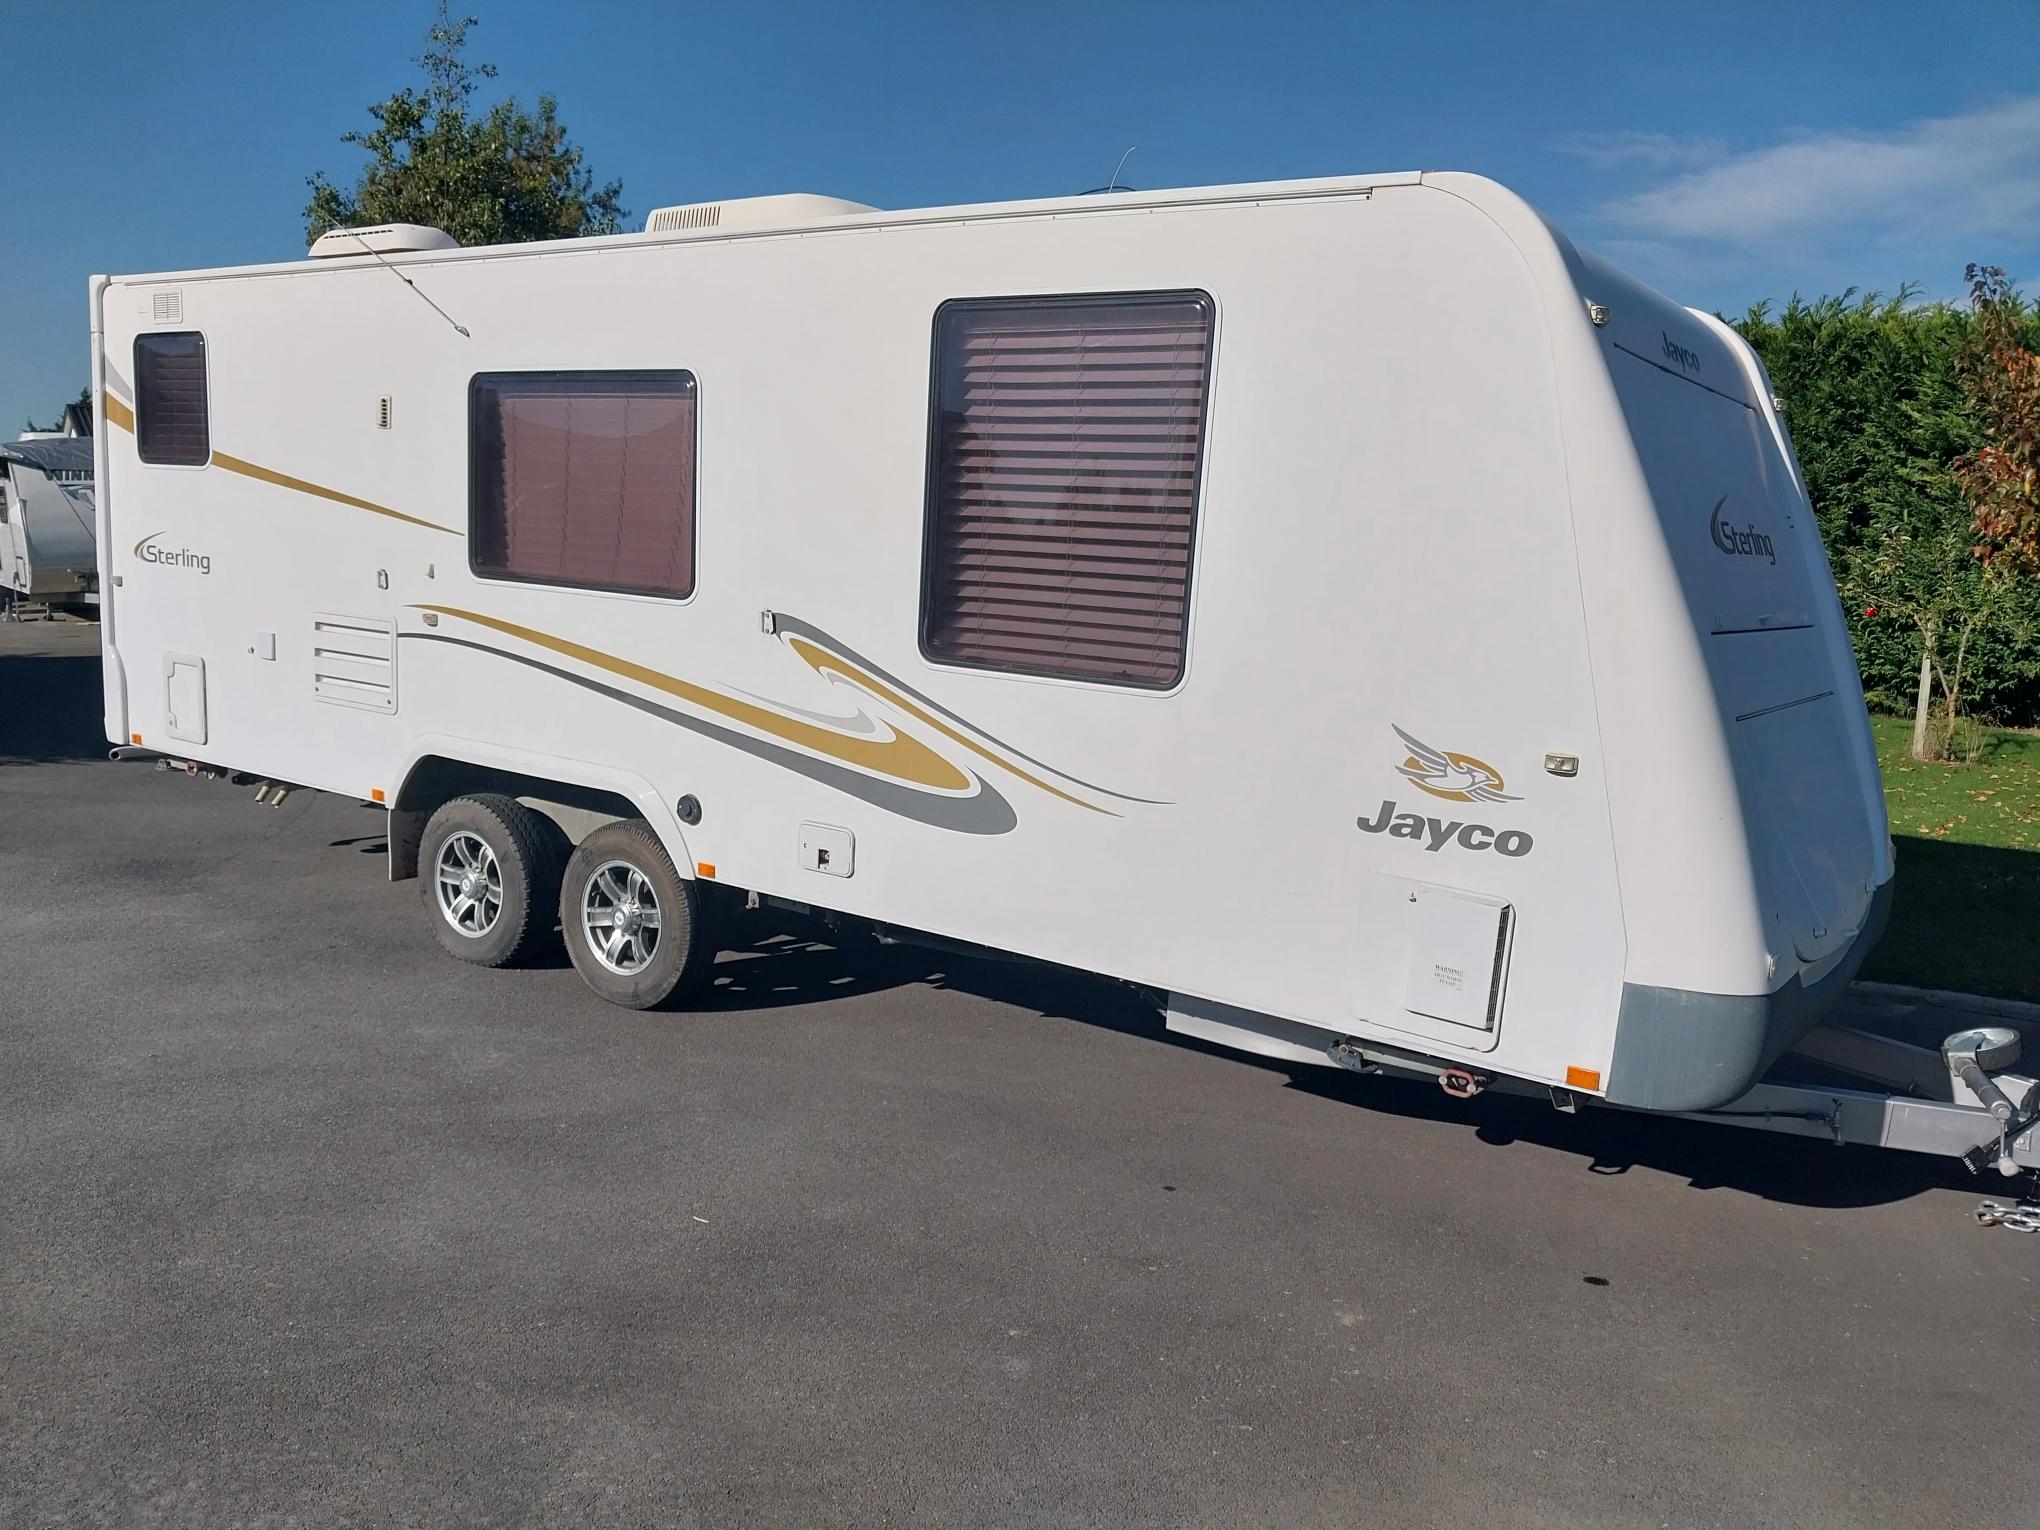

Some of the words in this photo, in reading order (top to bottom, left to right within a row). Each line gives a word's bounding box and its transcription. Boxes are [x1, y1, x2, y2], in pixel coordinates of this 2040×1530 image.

[1662, 330, 1701, 373] Jayco
[139, 544, 211, 575] Sterling
[1717, 520, 1777, 566] Sterling
[1356, 800, 1534, 857] Jayco
